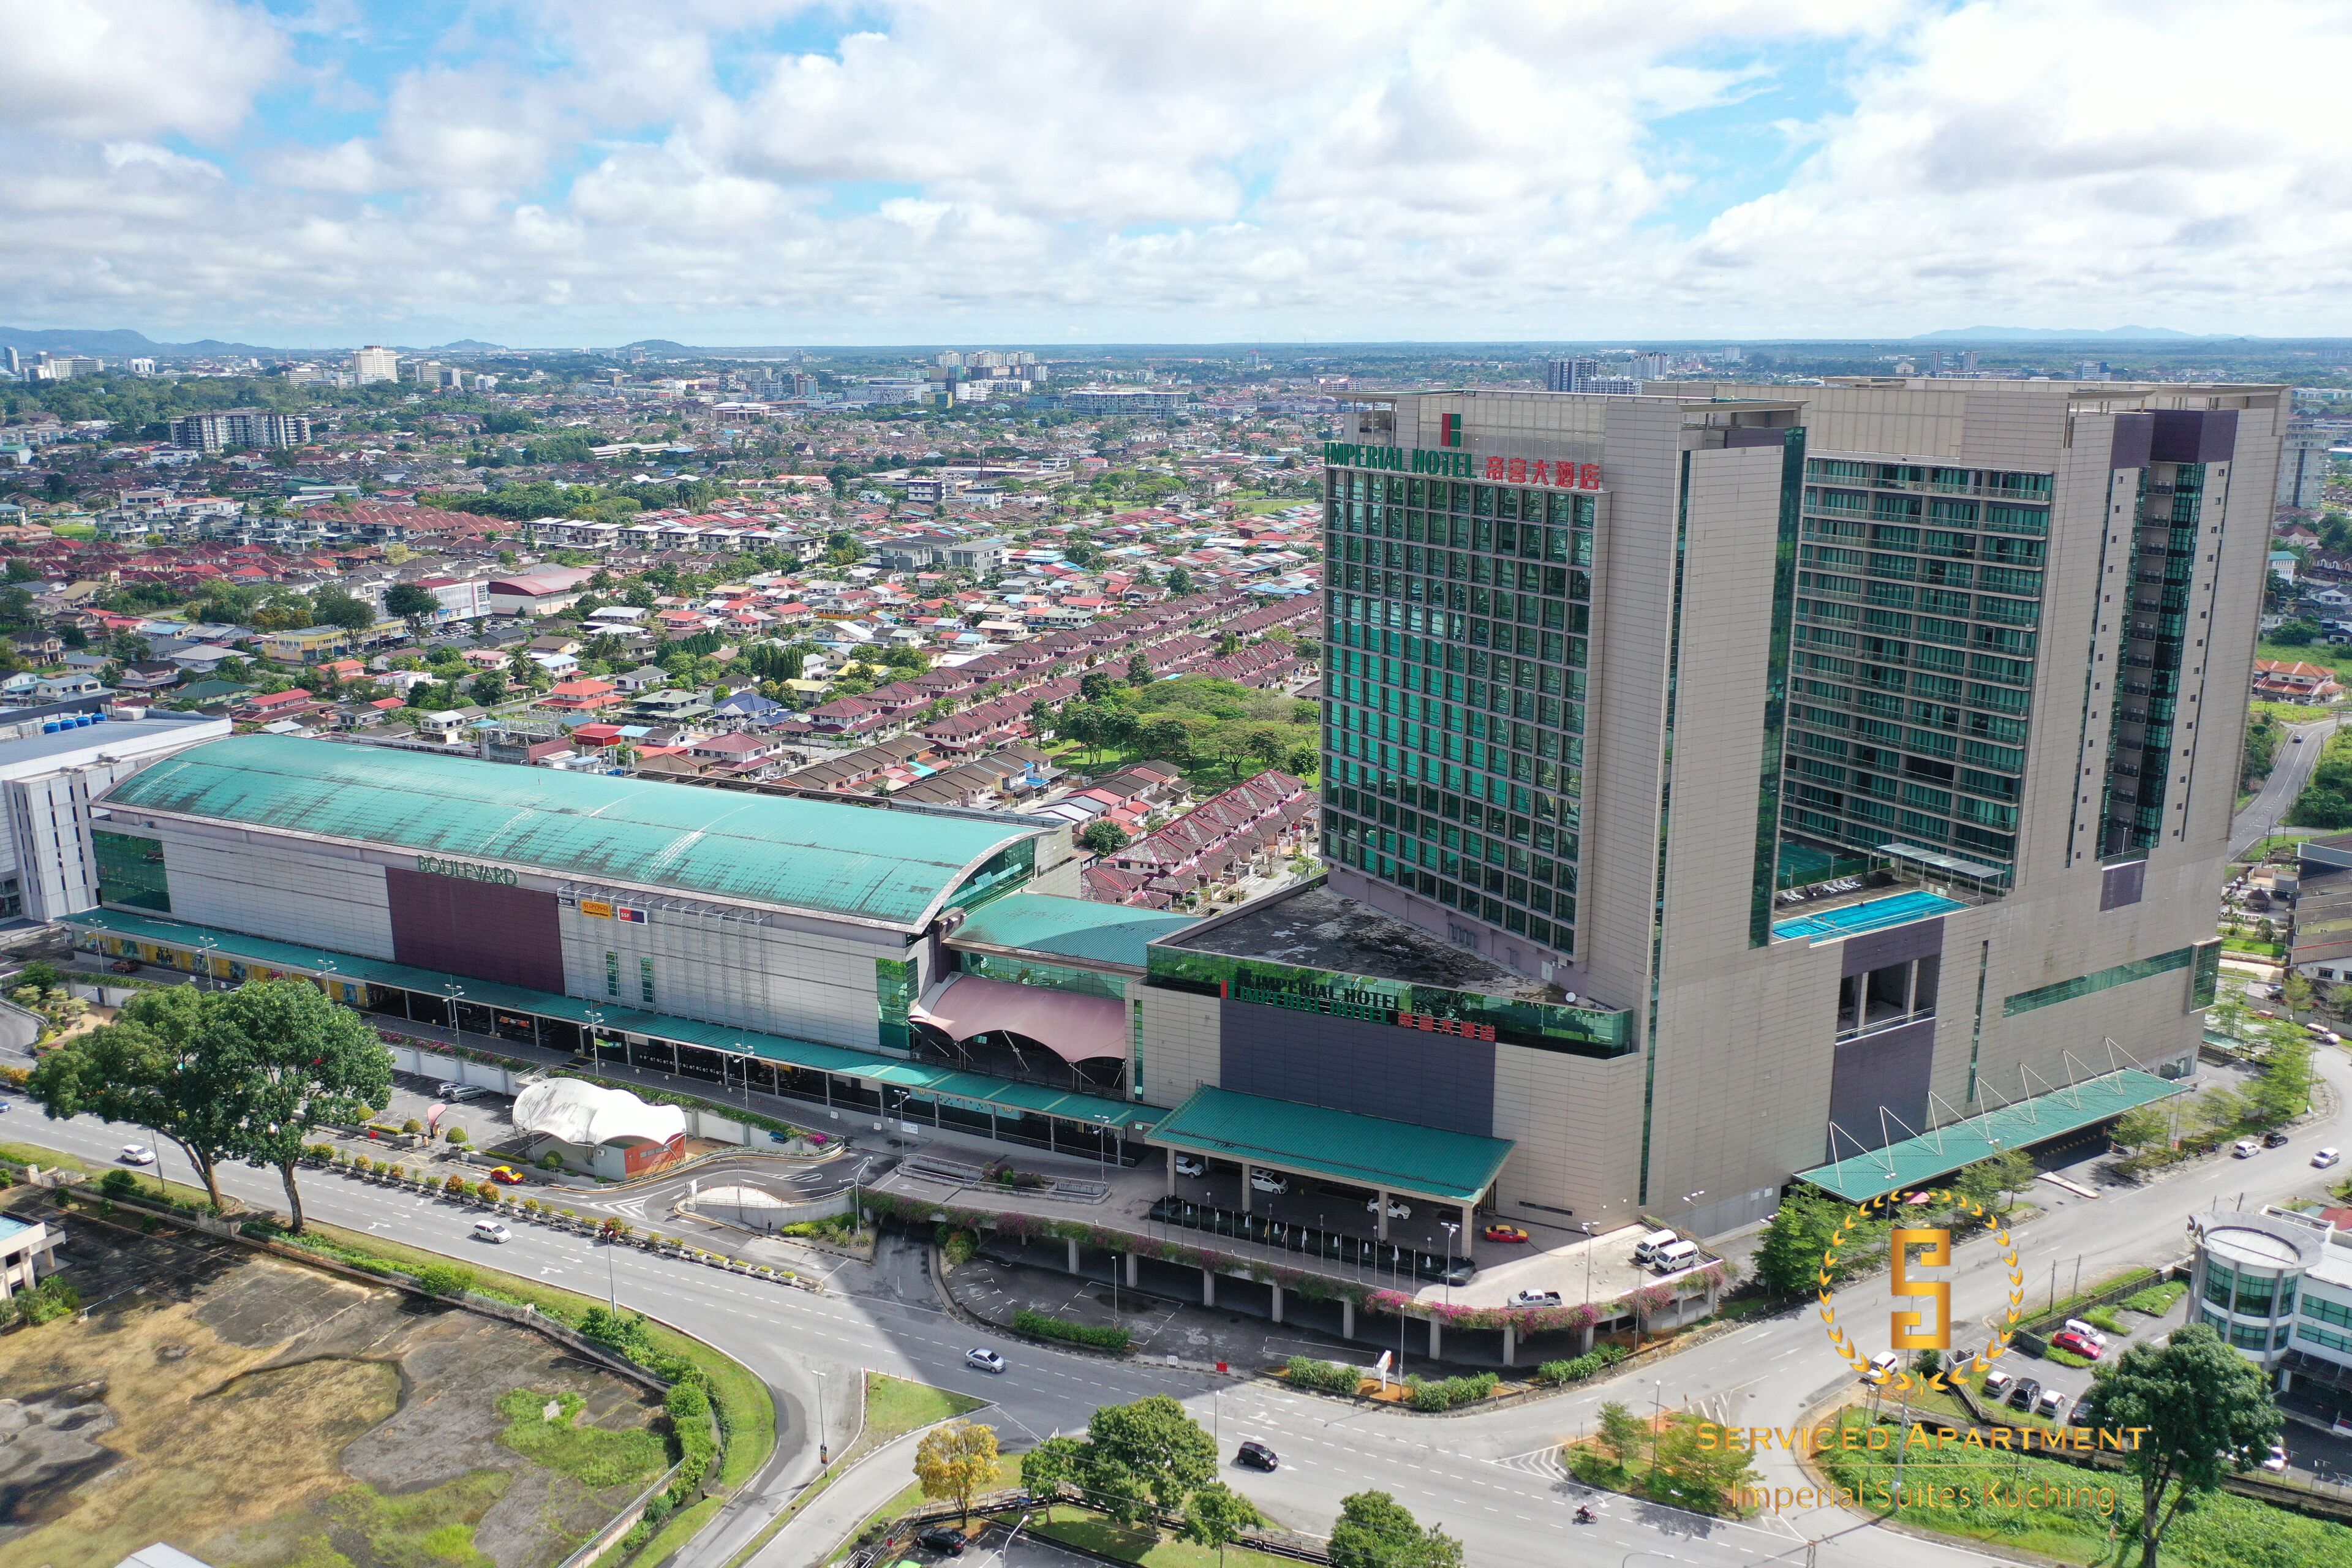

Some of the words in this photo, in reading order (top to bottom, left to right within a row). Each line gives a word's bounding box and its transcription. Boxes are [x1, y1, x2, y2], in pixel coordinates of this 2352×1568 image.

[1324, 442, 1407, 472] IMPERIAL
[1411, 448, 1477, 479] HOTEL
[417, 854, 519, 886] BOULEVARD
[1240, 986, 1324, 1015] IMPERIAL
[1330, 998, 1392, 1025] HOTEL
